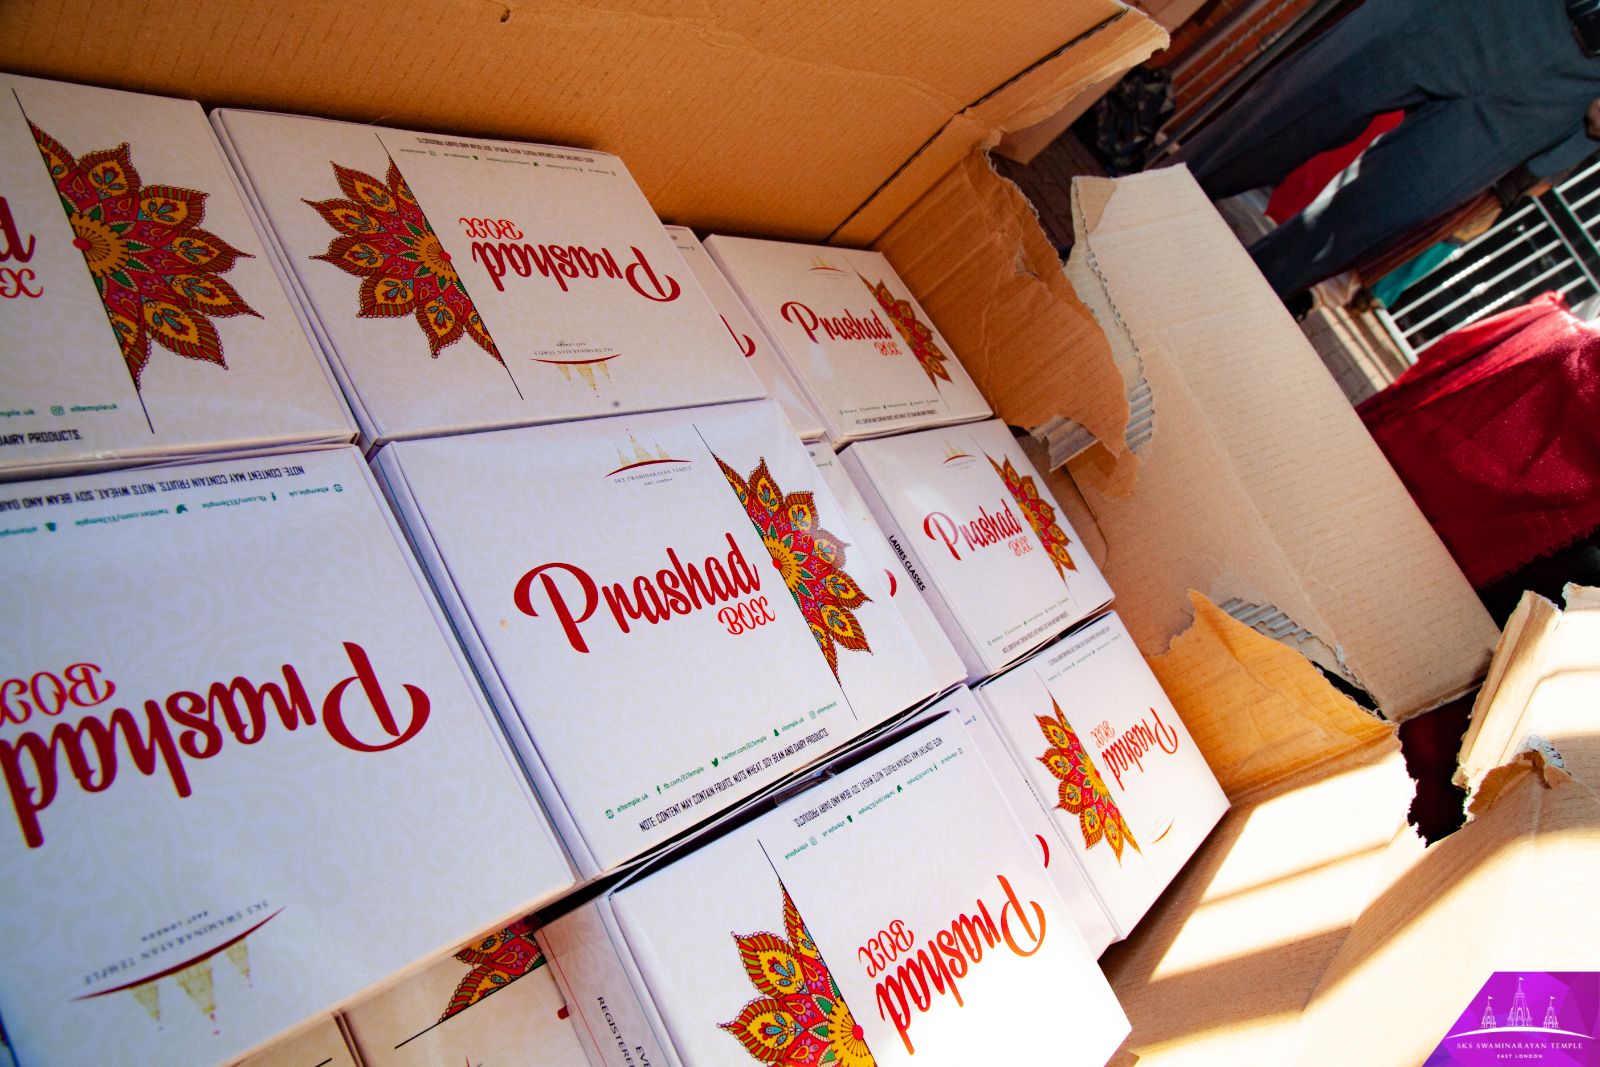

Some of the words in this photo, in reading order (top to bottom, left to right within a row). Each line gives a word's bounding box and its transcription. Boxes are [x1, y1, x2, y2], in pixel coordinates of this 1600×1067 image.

[459, 217, 524, 240] BOX
[472, 241, 681, 302] Prashad
[780, 301, 892, 344] Prashad
[130, 483, 156, 495] NUTS
[190, 474, 228, 487] CONTAIN
[229, 472, 247, 483] MAY
[247, 468, 282, 481] CONTENT
[22, 496, 43, 508] AND
[45, 493, 73, 505] BEAN
[74, 490, 95, 502] SOY
[923, 498, 1023, 560] Prashad
[888, 534, 908, 560] LADIES
[903, 558, 927, 592] CLASSES
[514, 533, 760, 653] Prashad
[717, 596, 776, 634] BOX
[0, 642, 430, 849] Prashad
[1102, 707, 1178, 791] Prashad
[655, 803, 681, 824] CONTENT
[680, 799, 692, 810] MAY
[692, 787, 716, 805] CONTAIN
[732, 770, 747, 782] NUTS
[762, 757, 773, 768] SOY
[771, 751, 785, 763] BEAN
[784, 745, 795, 756] AND
[792, 739, 807, 752] DAIRY
[858, 920, 914, 978] BOX
[876, 874, 1046, 1055] Prashad
[84, 958, 135, 985] TEMPLE
